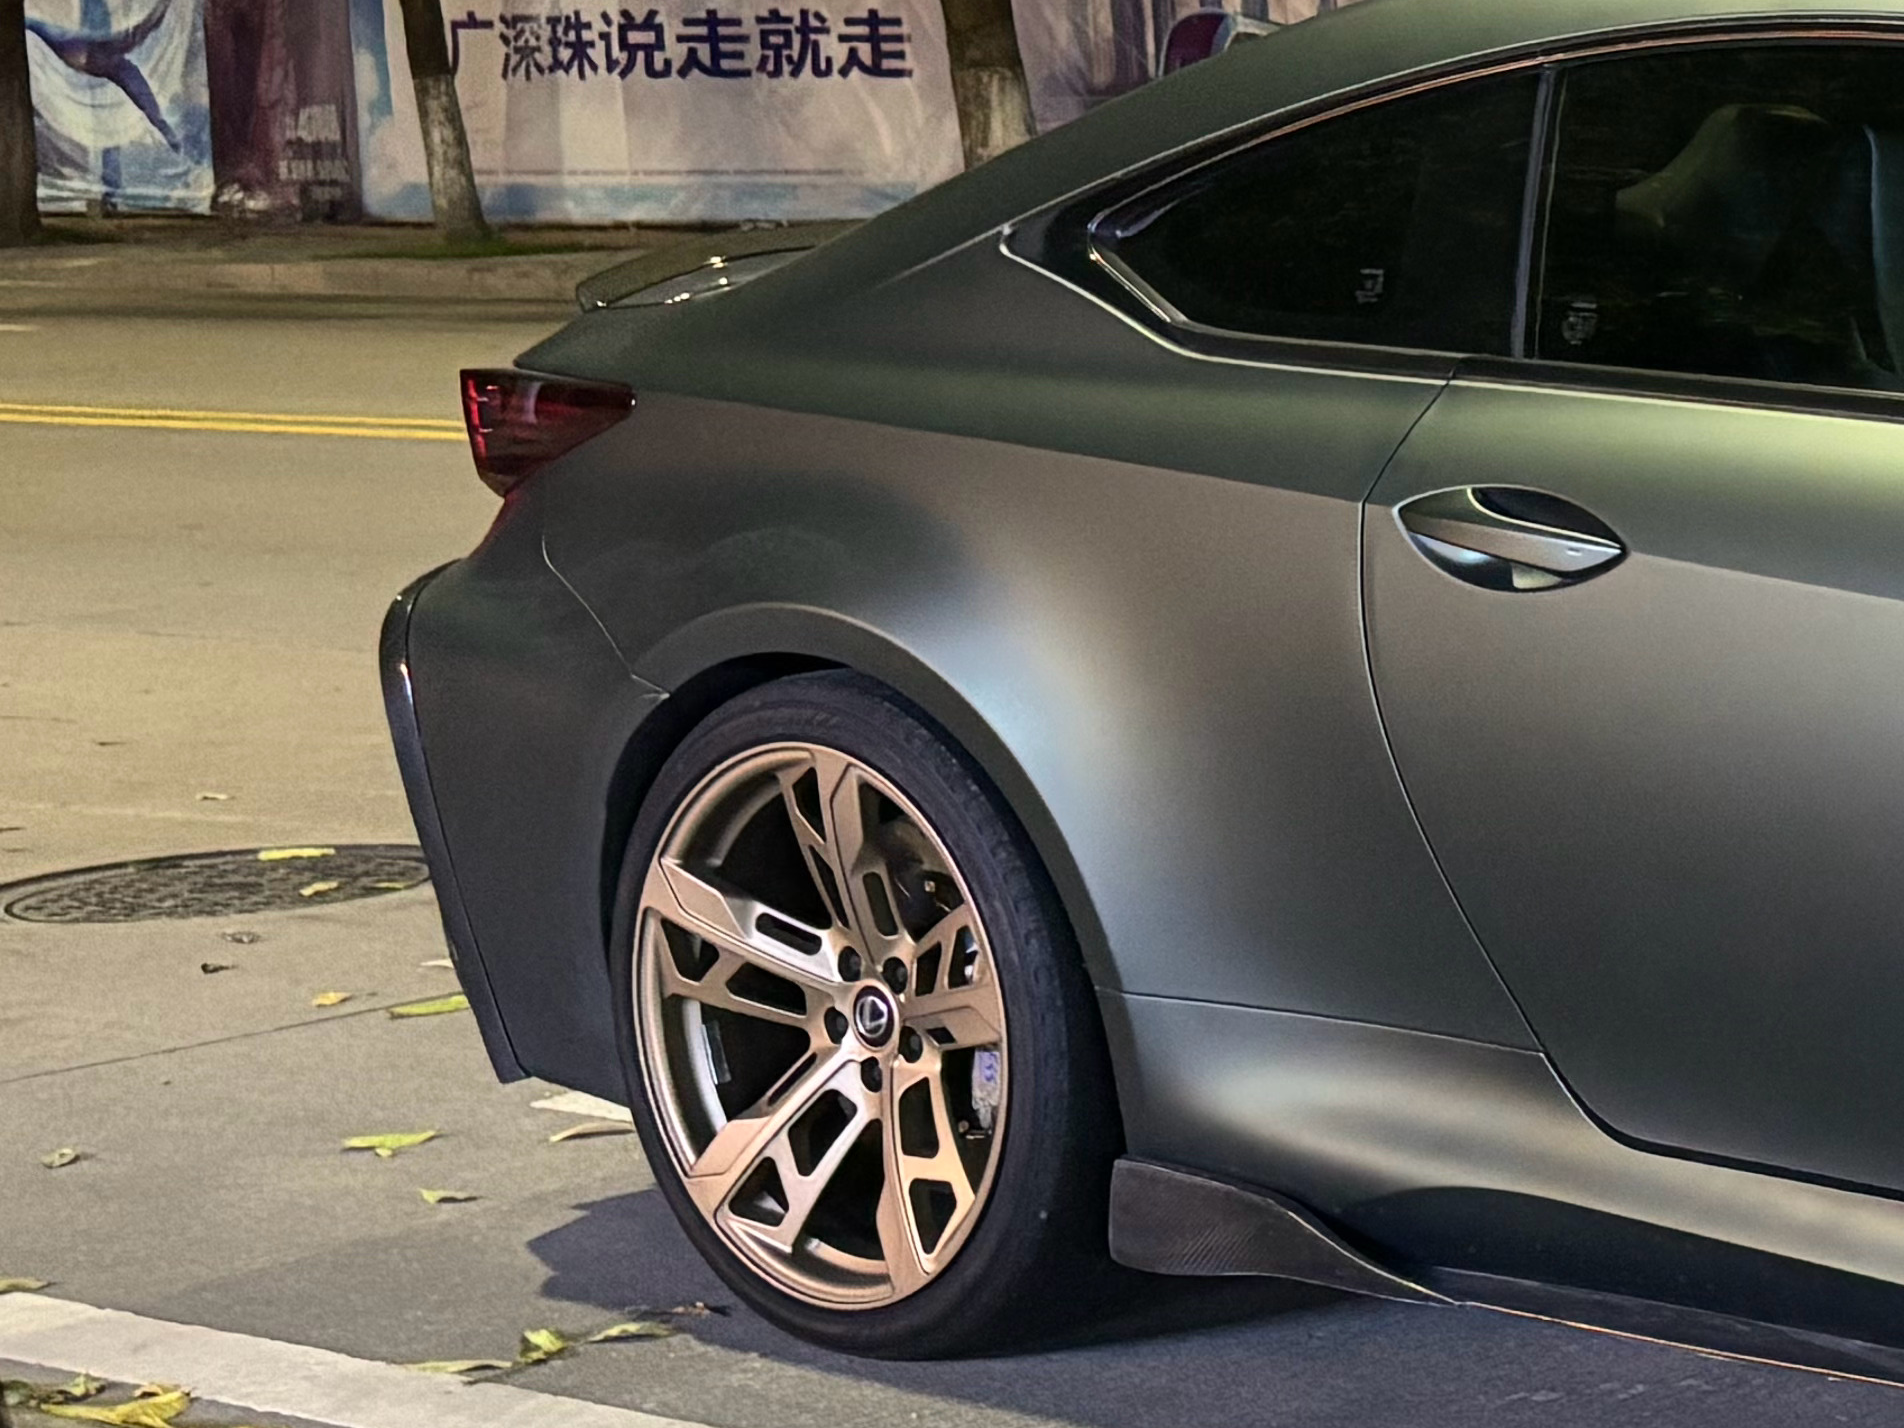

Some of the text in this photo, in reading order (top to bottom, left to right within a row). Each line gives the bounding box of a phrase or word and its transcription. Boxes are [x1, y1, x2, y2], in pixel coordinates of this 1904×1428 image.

[451, 8, 913, 82] 广深珠说走就走
